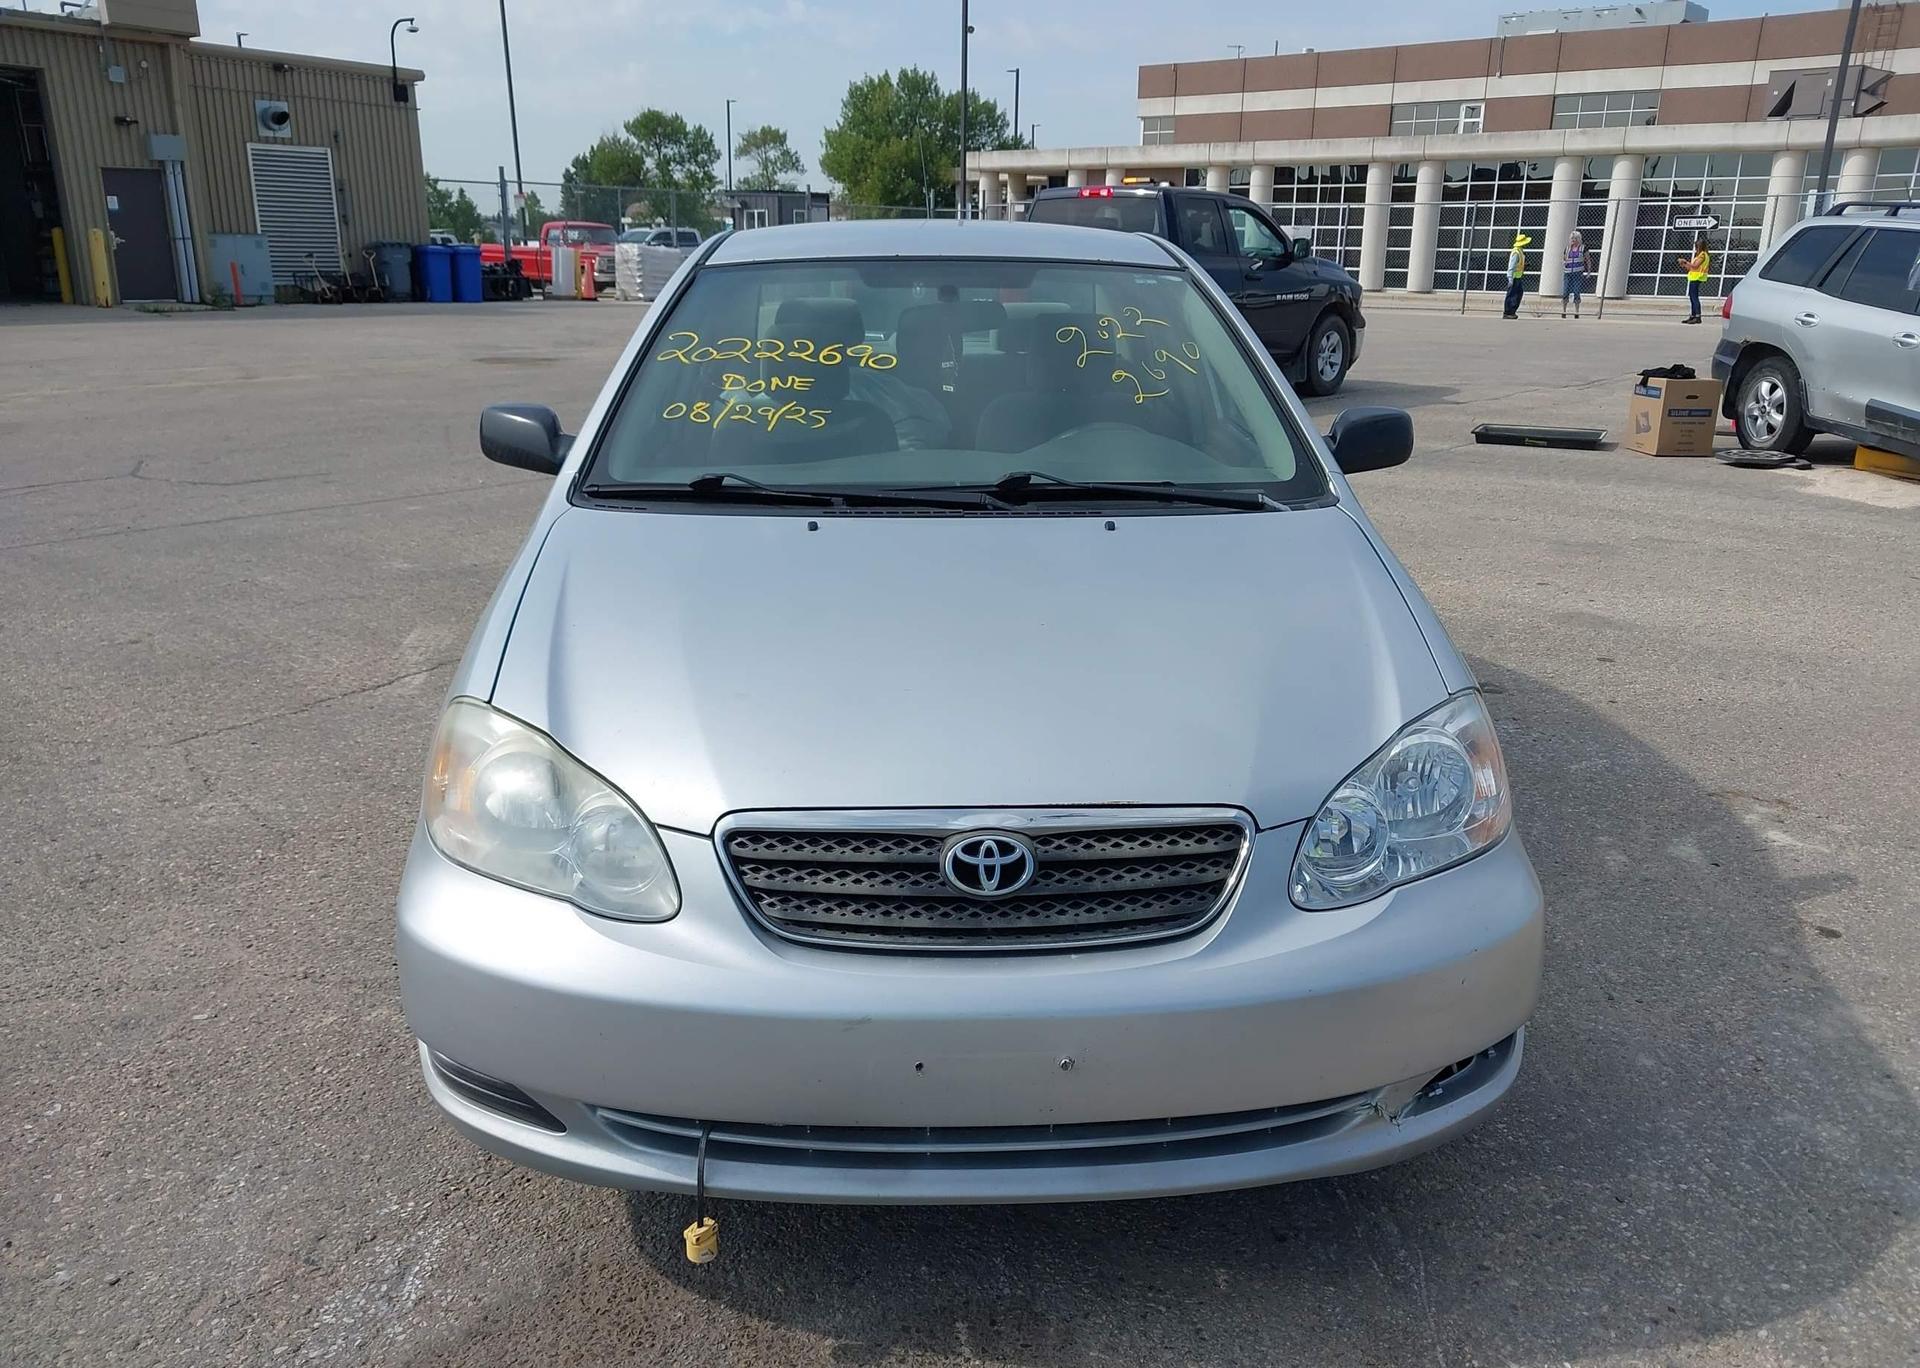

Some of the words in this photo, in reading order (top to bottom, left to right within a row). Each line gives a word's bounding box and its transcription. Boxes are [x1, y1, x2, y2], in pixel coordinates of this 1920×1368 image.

[657, 331, 898, 370] 20222690
[722, 373, 816, 393] DONE
[663, 398, 833, 432] 08/29/25
